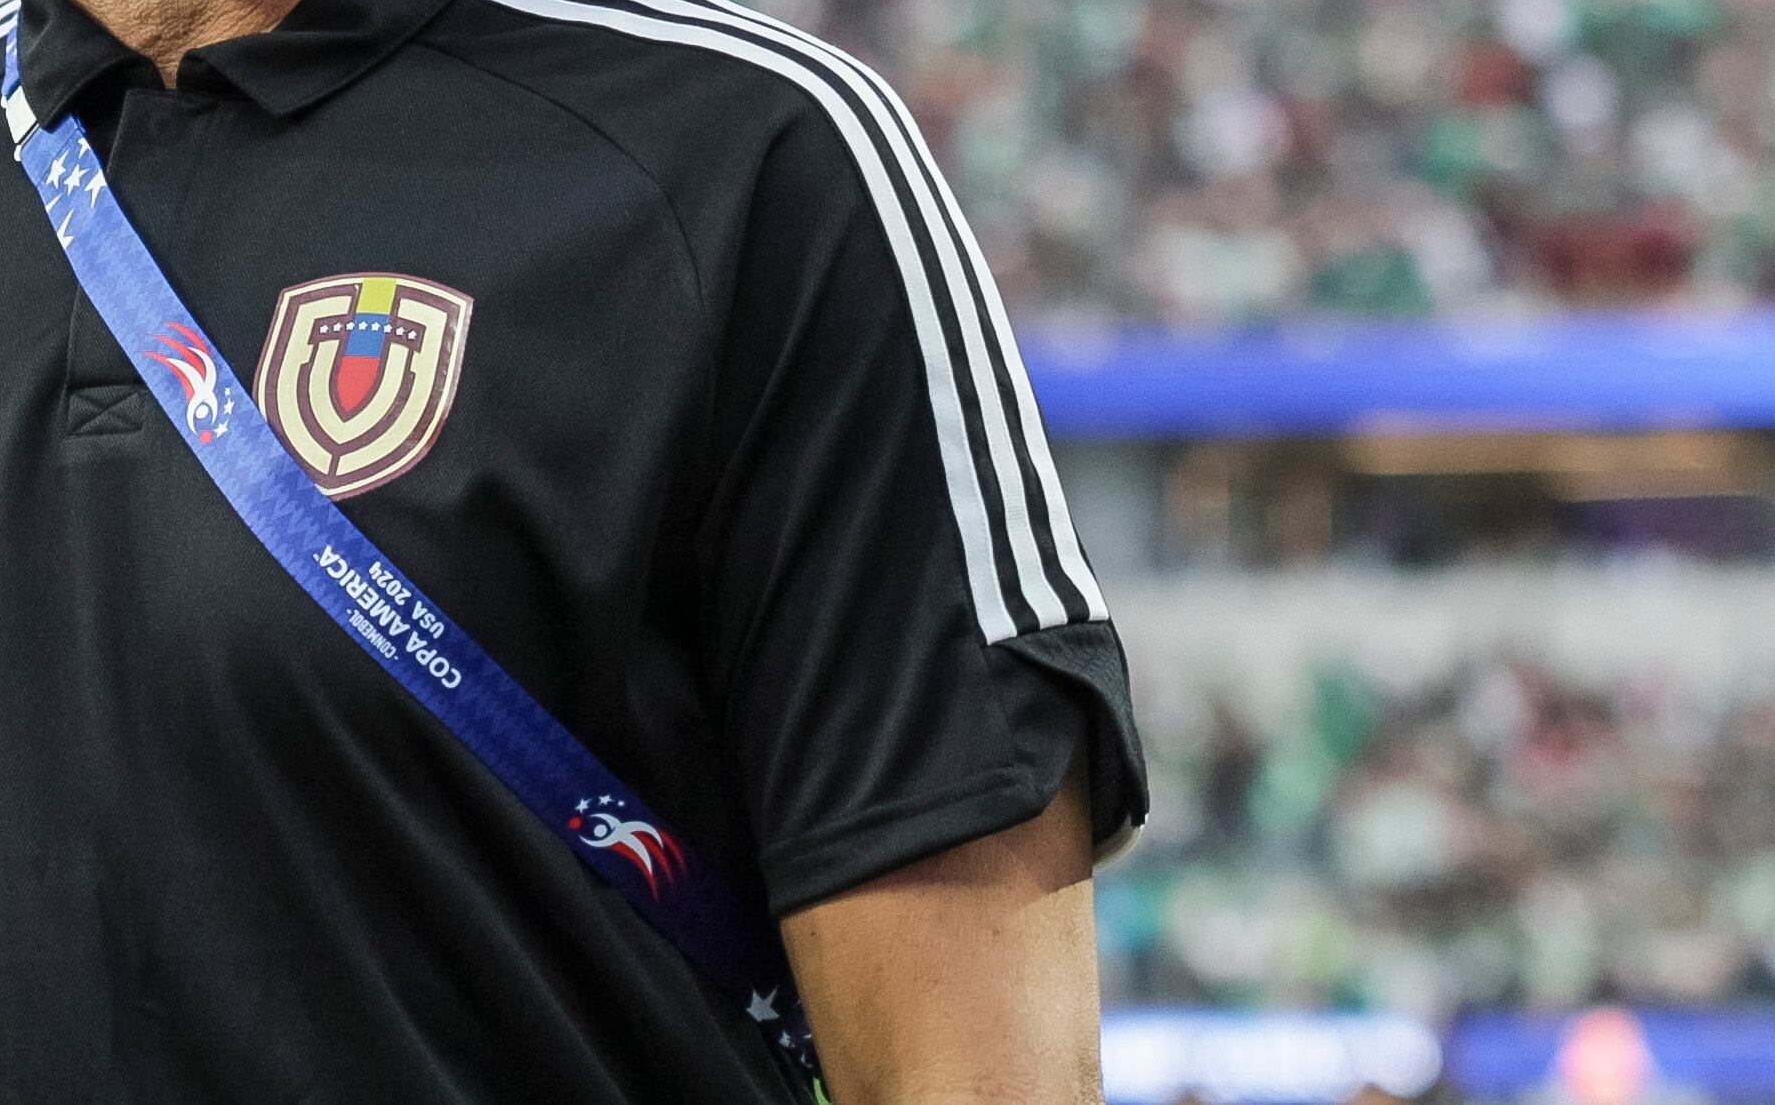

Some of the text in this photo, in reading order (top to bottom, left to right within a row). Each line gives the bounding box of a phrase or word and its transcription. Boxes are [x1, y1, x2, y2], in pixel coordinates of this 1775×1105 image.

[368, 561, 445, 640] USA 2024
[405, 630, 462, 689] COPA
